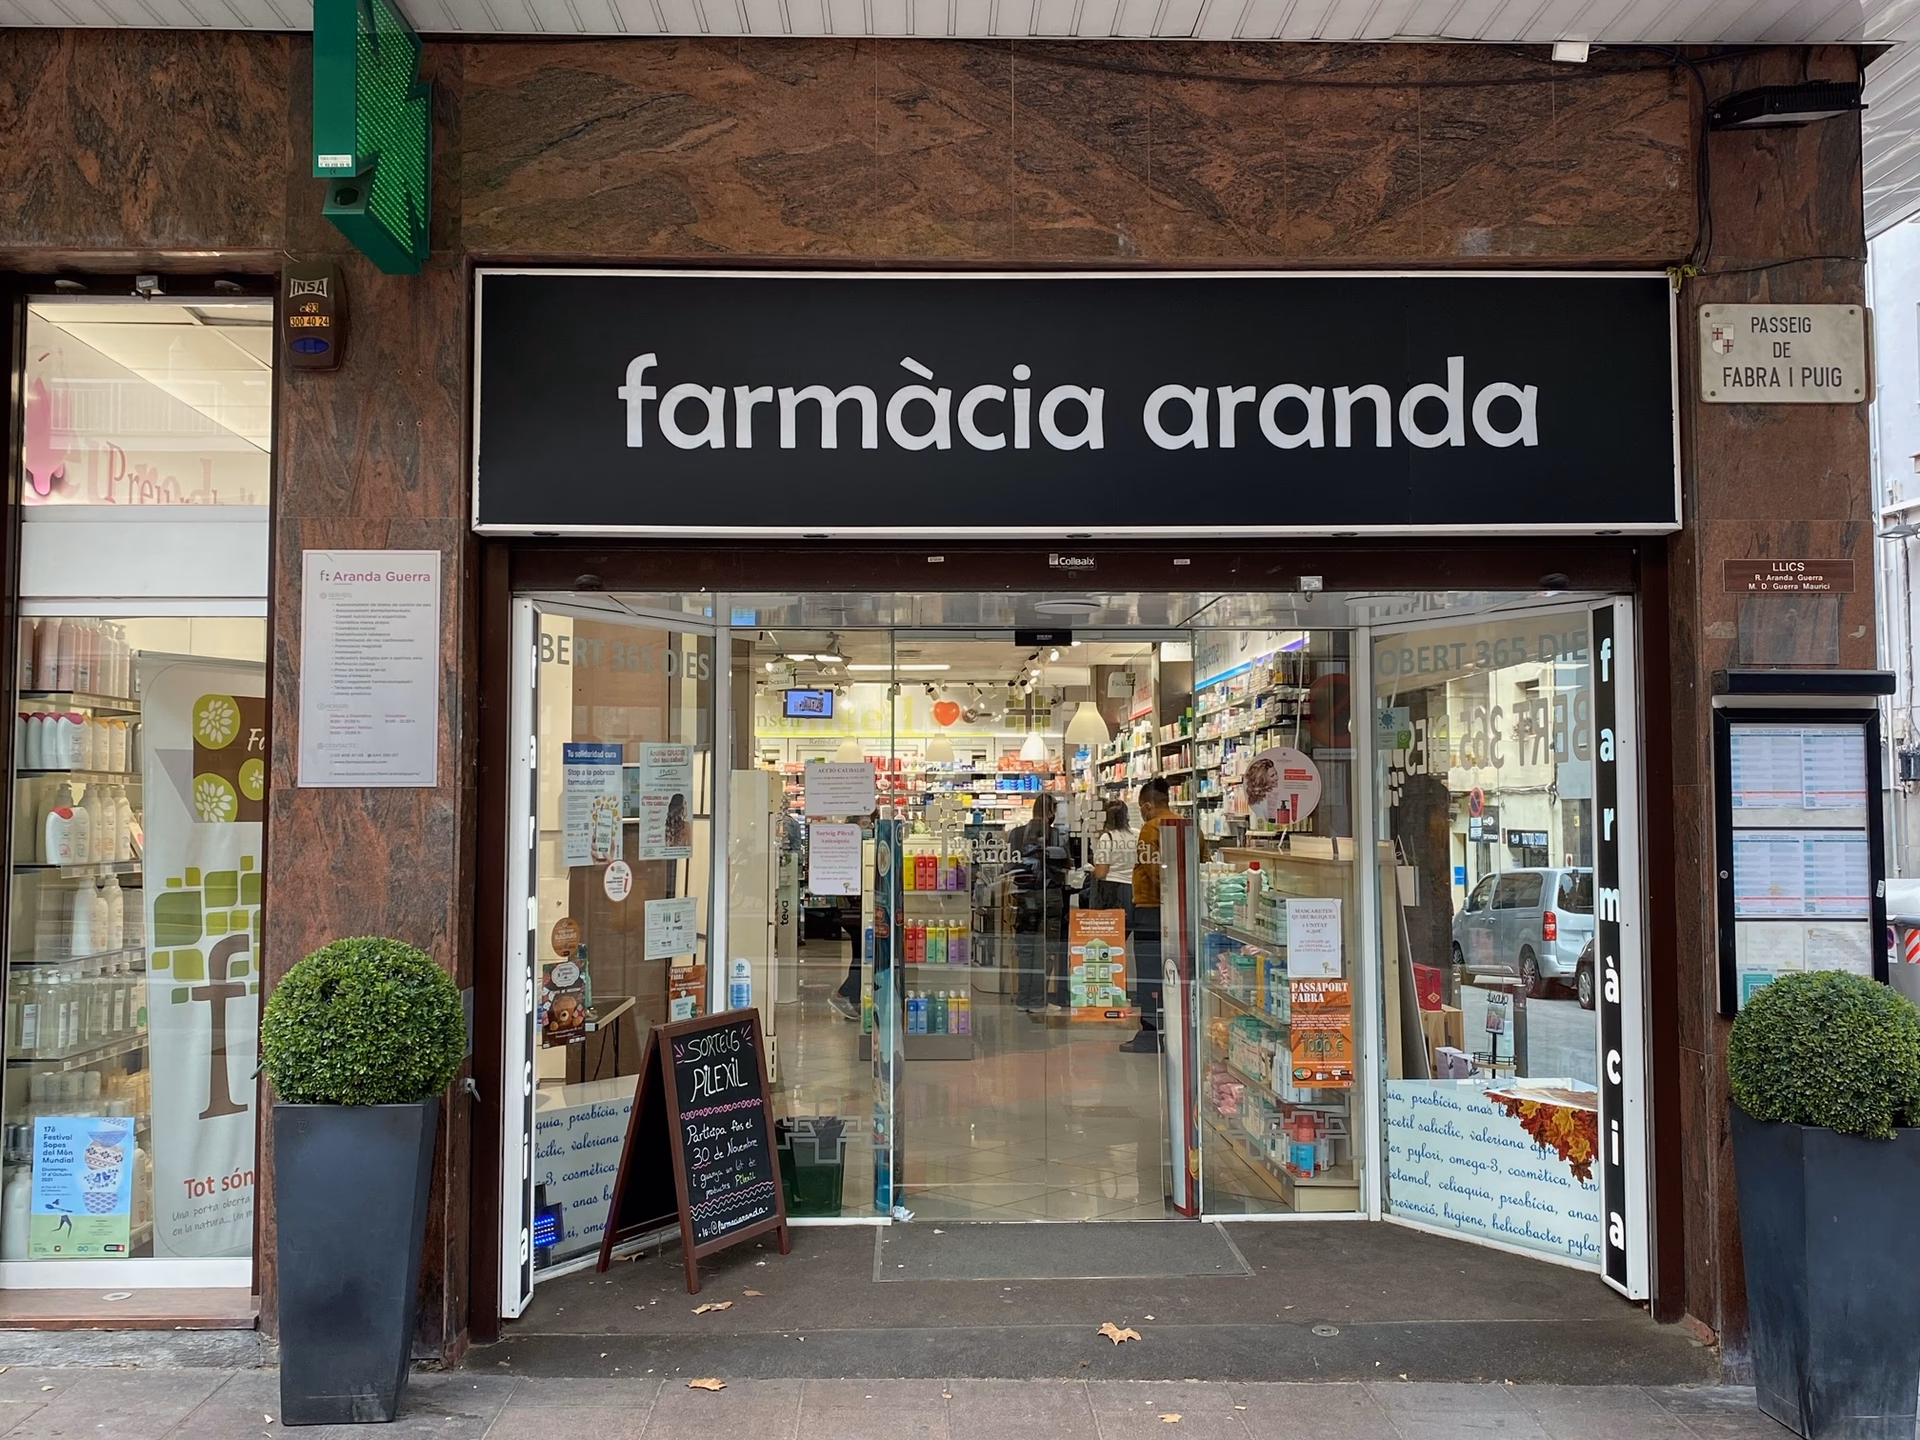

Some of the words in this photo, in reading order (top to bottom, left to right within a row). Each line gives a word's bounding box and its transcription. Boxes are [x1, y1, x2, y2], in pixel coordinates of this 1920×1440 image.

[292, 280, 326, 295] INSA
[308, 303, 318, 313] 93
[291, 316, 304, 326] 300
[307, 316, 316, 326] 40
[319, 316, 328, 326] 24
[1751, 316, 1812, 333] PASSEIG
[1773, 341, 1791, 358] DE
[1723, 366, 1781, 388] FABRA
[1789, 366, 1793, 388] I
[1801, 366, 1842, 388] PUIG
[617, 352, 1105, 451] farmàcia
[1143, 355, 1539, 451] aranda
[1772, 562, 1805, 572] LLICS
[332, 571, 381, 583] Aranda
[385, 571, 431, 583] Guerra
[663, 649, 710, 681] DIES
[1378, 642, 1467, 676] OBERT
[1475, 636, 1527, 668] 365
[567, 769, 581, 777] Stop
[780, 900, 789, 927] teva
[554, 932, 577, 940] RADARS
[1291, 982, 1349, 992] PASSAPORT
[1291, 993, 1325, 1003] FABRA
[1301, 1038, 1332, 1053] 1000
[1411, 1090, 1462, 1112] presbícia,
[1467, 1104, 1493, 1116] anas
[567, 1103, 619, 1131] presbícia,
[43, 1133, 73, 1141] Festival
[571, 1131, 619, 1152] valeriana
[686, 1122, 728, 1146] Participa
[1418, 1116, 1464, 1140] salicílic,
[1470, 1126, 1525, 1150] valeriana
[43, 1141, 67, 1149] Sopes
[692, 1146, 711, 1167] 30
[713, 1148, 725, 1161] de
[726, 1136, 758, 1158] Novembre
[562, 1161, 618, 1182] cosmètica,
[1407, 1142, 1444, 1163] pylori,
[1449, 1156, 1502, 1175] omega-3,
[1508, 1165, 1571, 1188] cosmètica,
[183, 1176, 216, 1199] Tot
[221, 1166, 254, 1192] són
[734, 1171, 757, 1187] Pilexil
[572, 1196, 599, 1209] anas
[1438, 1175, 1494, 1201] celiaquia,
[1499, 1190, 1558, 1216] presbícia,
[172, 1210, 190, 1222] Una
[193, 1203, 219, 1218] porta
[222, 1195, 251, 1210] oberta
[172, 1227, 183, 1237] en
[184, 1223, 192, 1233] la
[1443, 1201, 1487, 1228] higiene,
[1492, 1213, 1563, 1245] helicobacter
